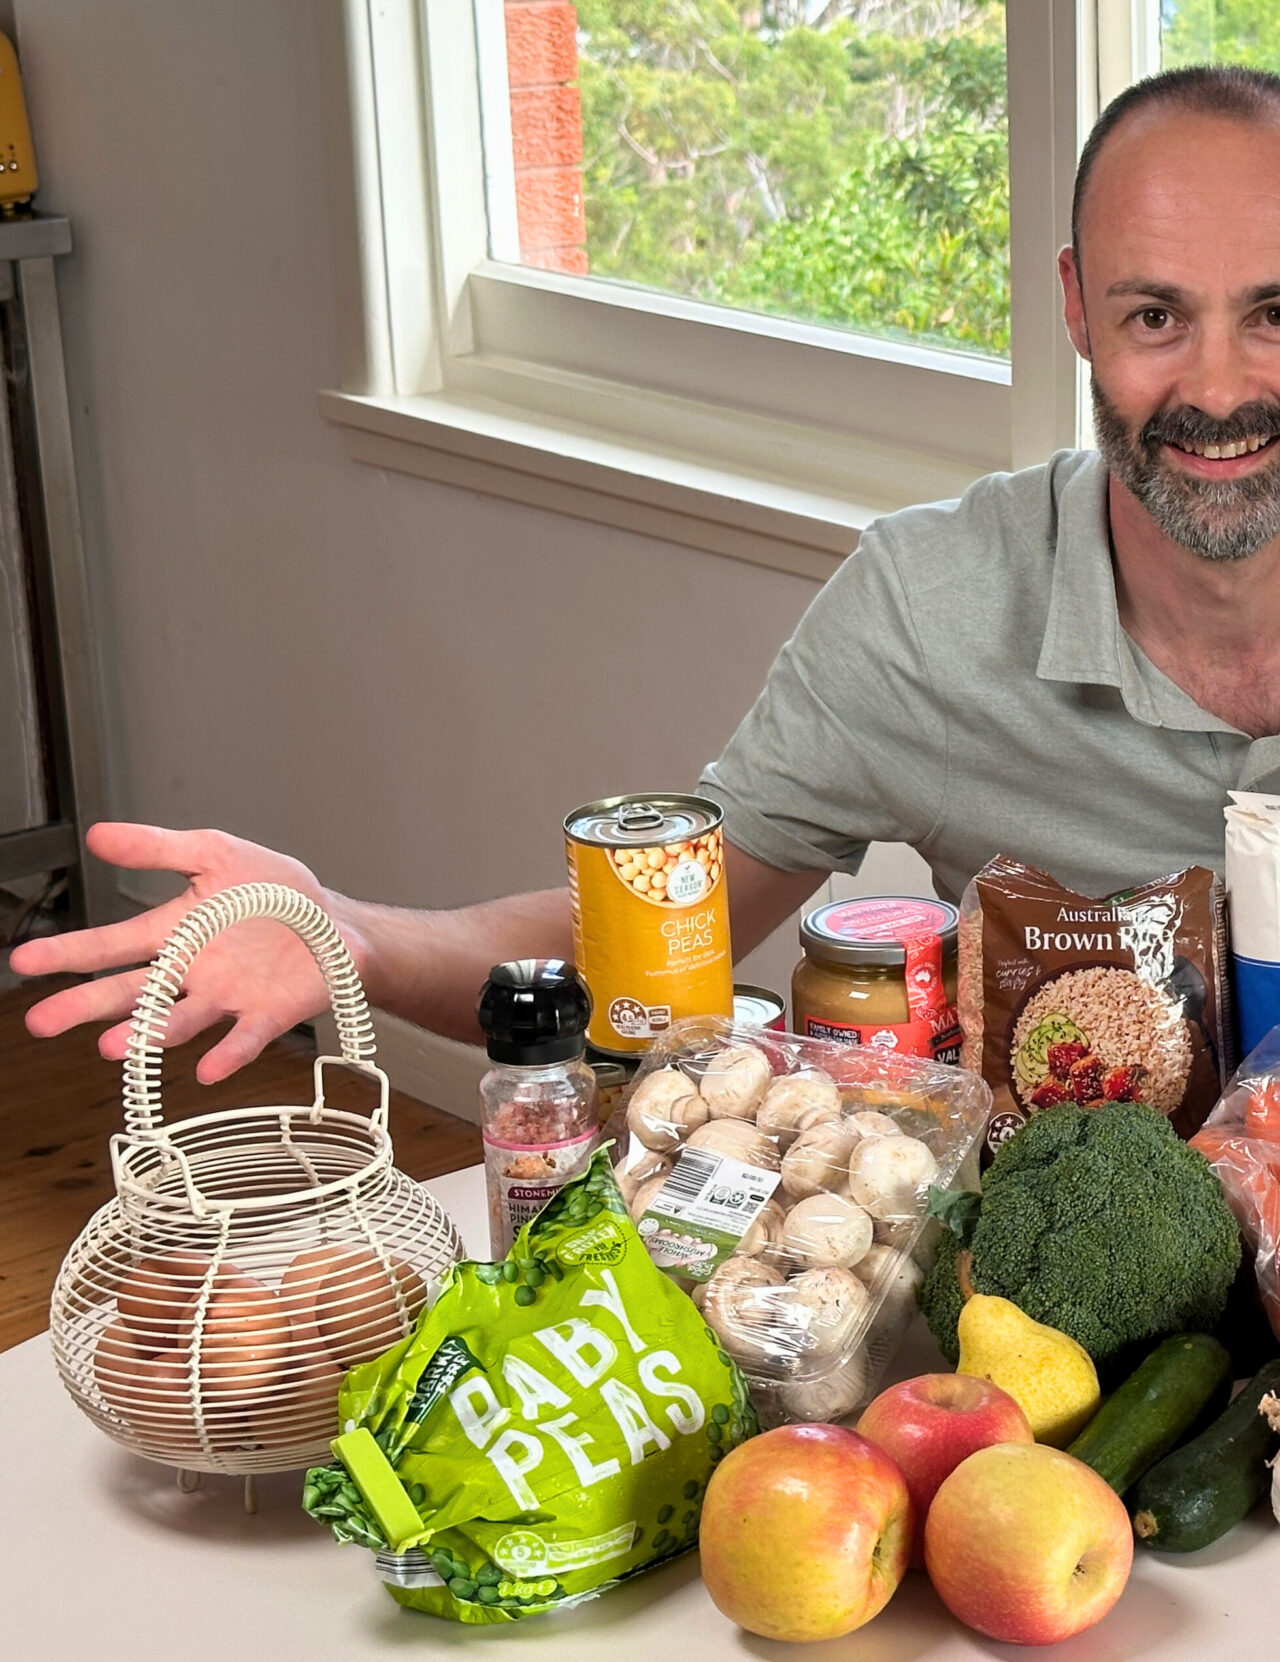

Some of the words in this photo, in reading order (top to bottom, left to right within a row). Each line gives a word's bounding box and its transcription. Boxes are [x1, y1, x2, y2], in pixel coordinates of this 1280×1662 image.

[674, 880, 702, 895] SEASON
[681, 875, 695, 885] NEW
[660, 908, 716, 937] CHICK
[1056, 907, 1140, 922] Australia
[668, 929, 714, 956] PEAS
[1024, 926, 1113, 951] Brown
[809, 1021, 830, 1034] FAMILY
[832, 1029, 858, 1039] OWNED
[651, 1237, 706, 1256] MUSHROOMS
[658, 1246, 688, 1259] WHOLE
[409, 1339, 467, 1409] MARKET
[485, 1350, 706, 1511] PEAS
[514, 1583, 534, 1596] kg
